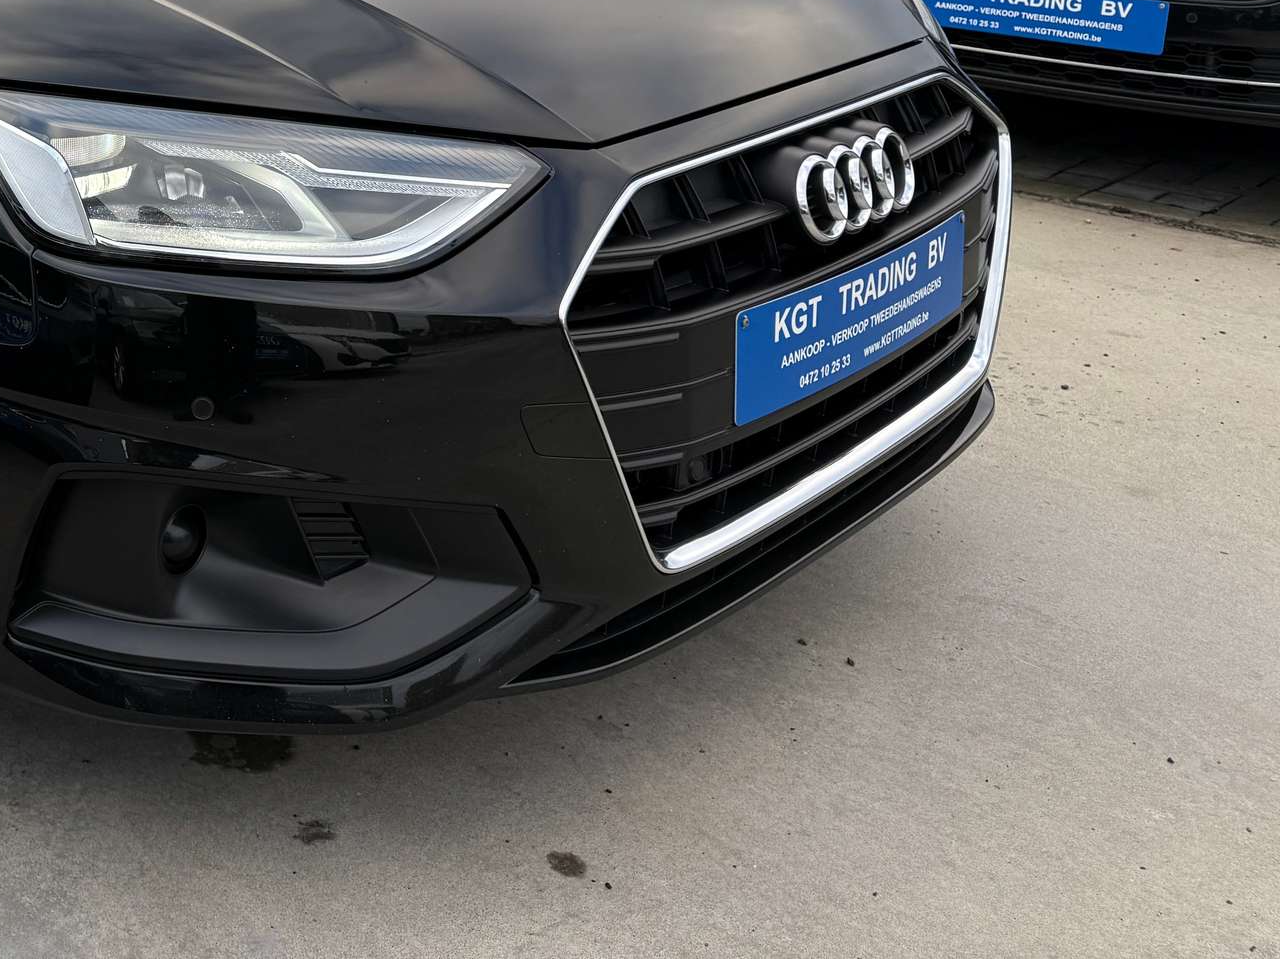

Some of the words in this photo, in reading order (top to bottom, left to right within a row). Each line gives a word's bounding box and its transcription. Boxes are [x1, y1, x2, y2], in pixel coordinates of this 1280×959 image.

[935, 1, 974, 12] AANKOOP
[980, 7, 1019, 18] VERKOOP
[1021, 12, 1123, 31] TWEEDEHANDSWAGENS
[949, 16, 967, 25] 0472
[969, 18, 978, 26] 10
[990, 21, 1000, 29] 33
[1013, 25, 1102, 42] www.KGTTRADING.be
[1101, 0, 1133, 18] BV
[774, 296, 822, 343] KGT
[838, 251, 917, 315] TRADING
[927, 232, 947, 270] BV
[781, 339, 825, 369] AANKOOP
[831, 318, 869, 346] VERKOOP
[870, 276, 942, 327] TWEEDEHANDSWAGENS
[799, 369, 819, 388] 0472
[820, 363, 830, 378] 10
[831, 358, 840, 374] 25
[841, 353, 851, 368] 33
[863, 311, 929, 357] www.KGTTRADING.be
